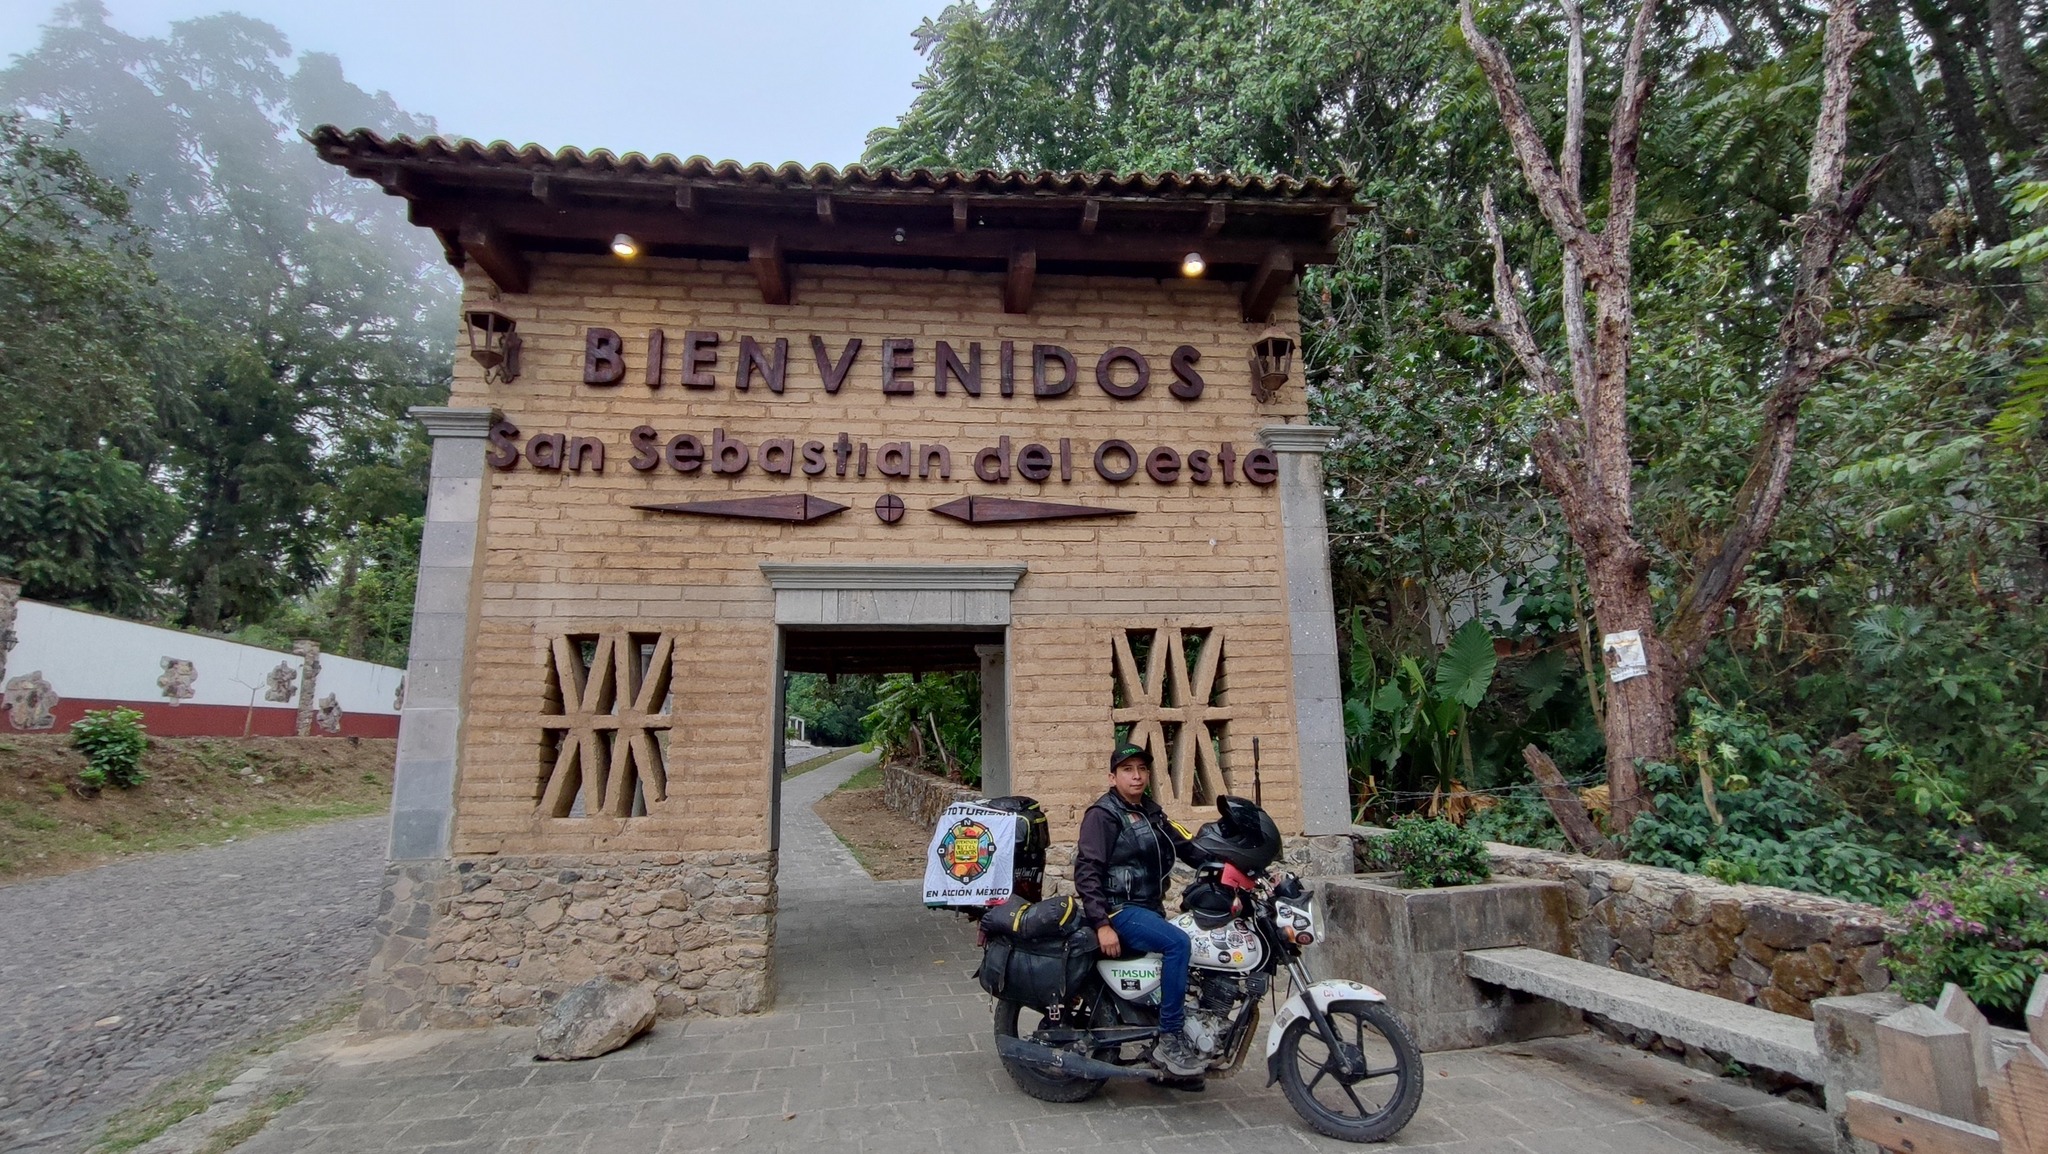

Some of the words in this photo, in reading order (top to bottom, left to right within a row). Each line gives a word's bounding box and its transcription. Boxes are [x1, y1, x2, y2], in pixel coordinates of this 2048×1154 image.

[583, 327, 1204, 400] BIENVENIDOS
[487, 418, 605, 472] San
[628, 425, 951, 478] Sebastian
[973, 435, 1071, 482] del
[1093, 439, 1278, 485] Oeste
[926, 890, 939, 898] EN
[975, 886, 1010, 896] MÉXICO
[1111, 969, 1156, 978] TIMSUN
